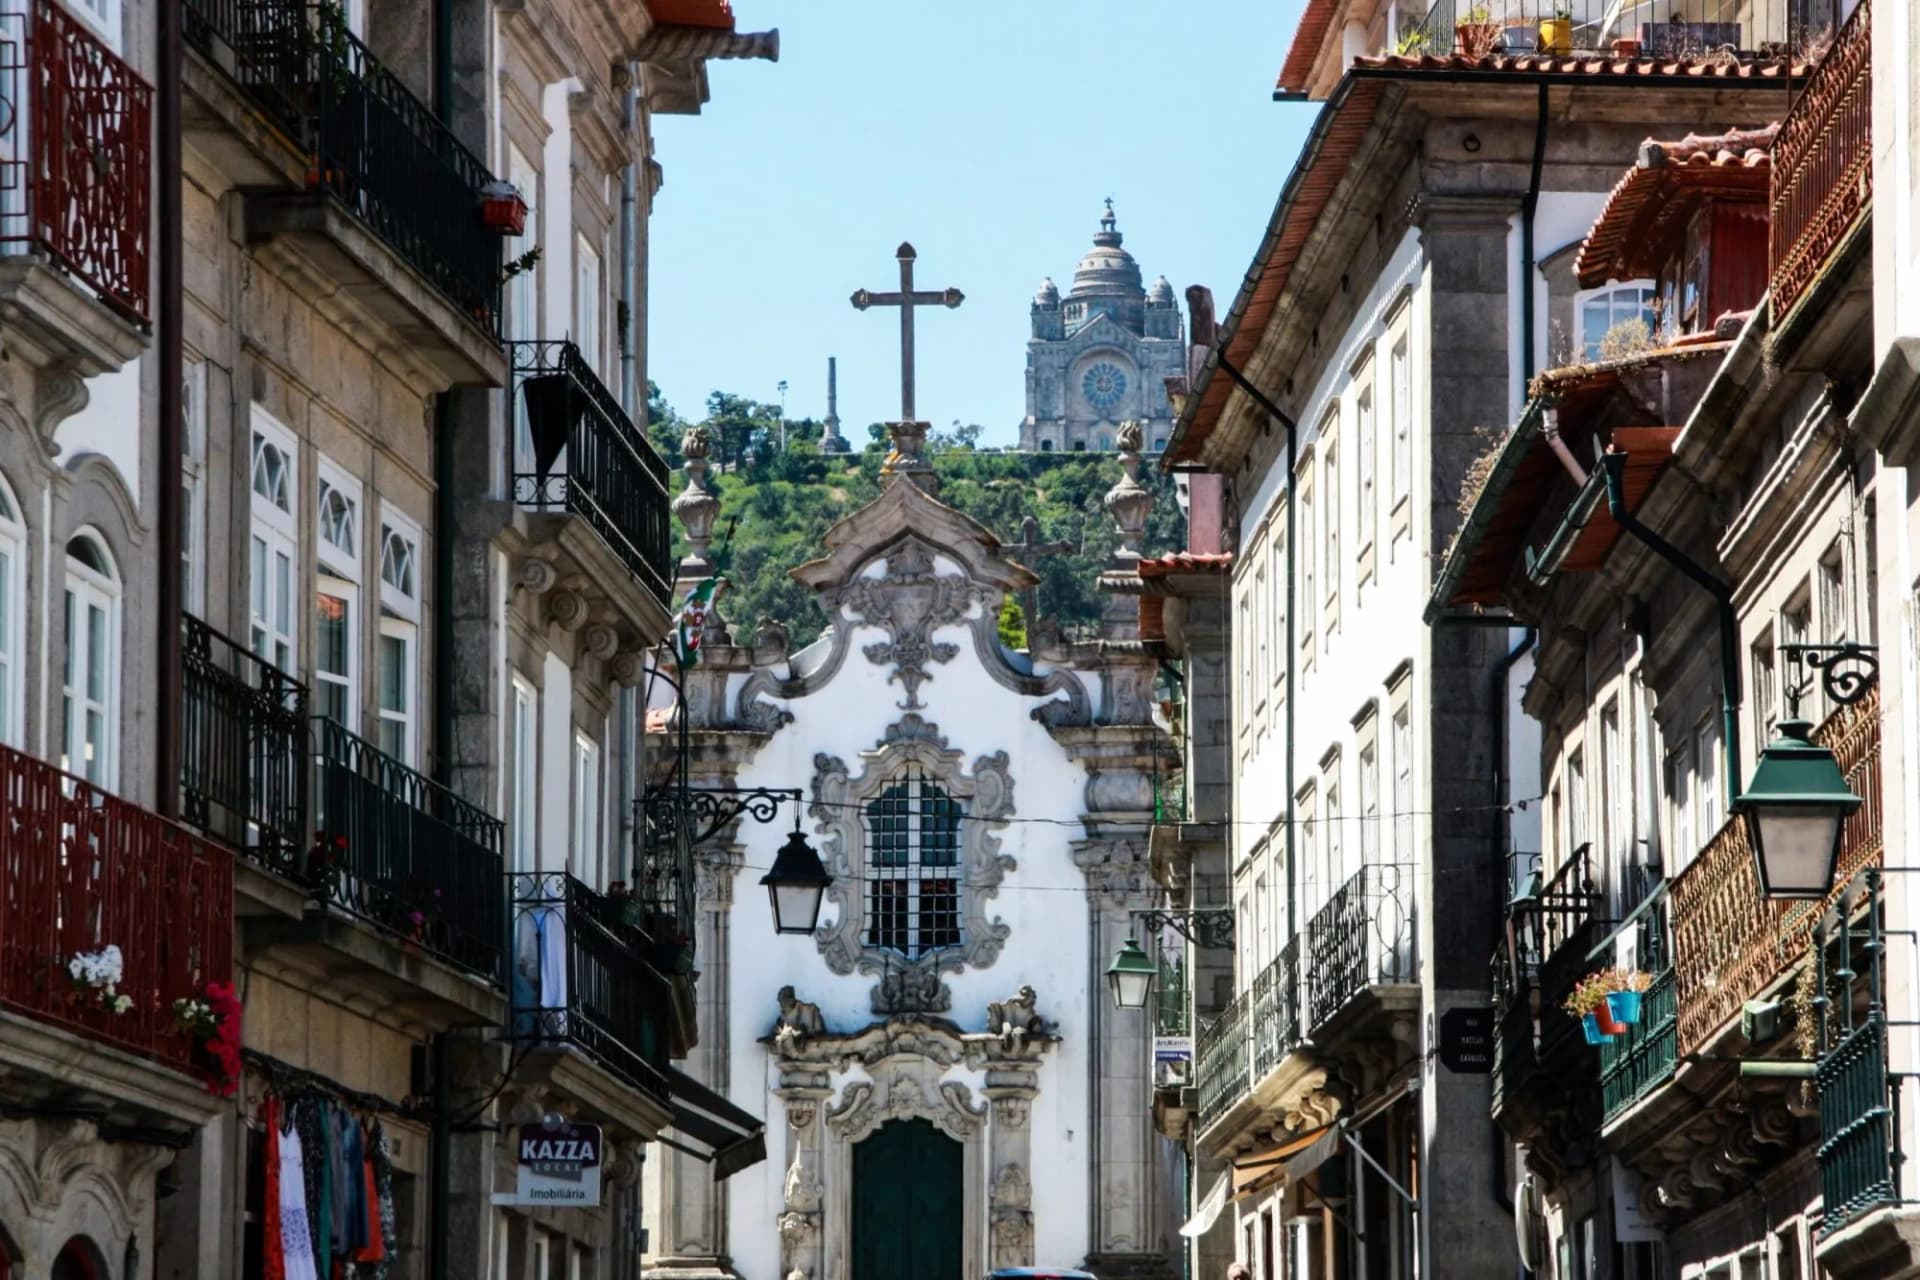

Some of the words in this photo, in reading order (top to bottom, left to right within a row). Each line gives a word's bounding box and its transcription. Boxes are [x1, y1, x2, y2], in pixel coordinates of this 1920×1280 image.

[521, 1139, 595, 1160] KAZZA
[535, 1163, 579, 1172] LOCAL
[530, 1187, 585, 1199] Imobiliária
